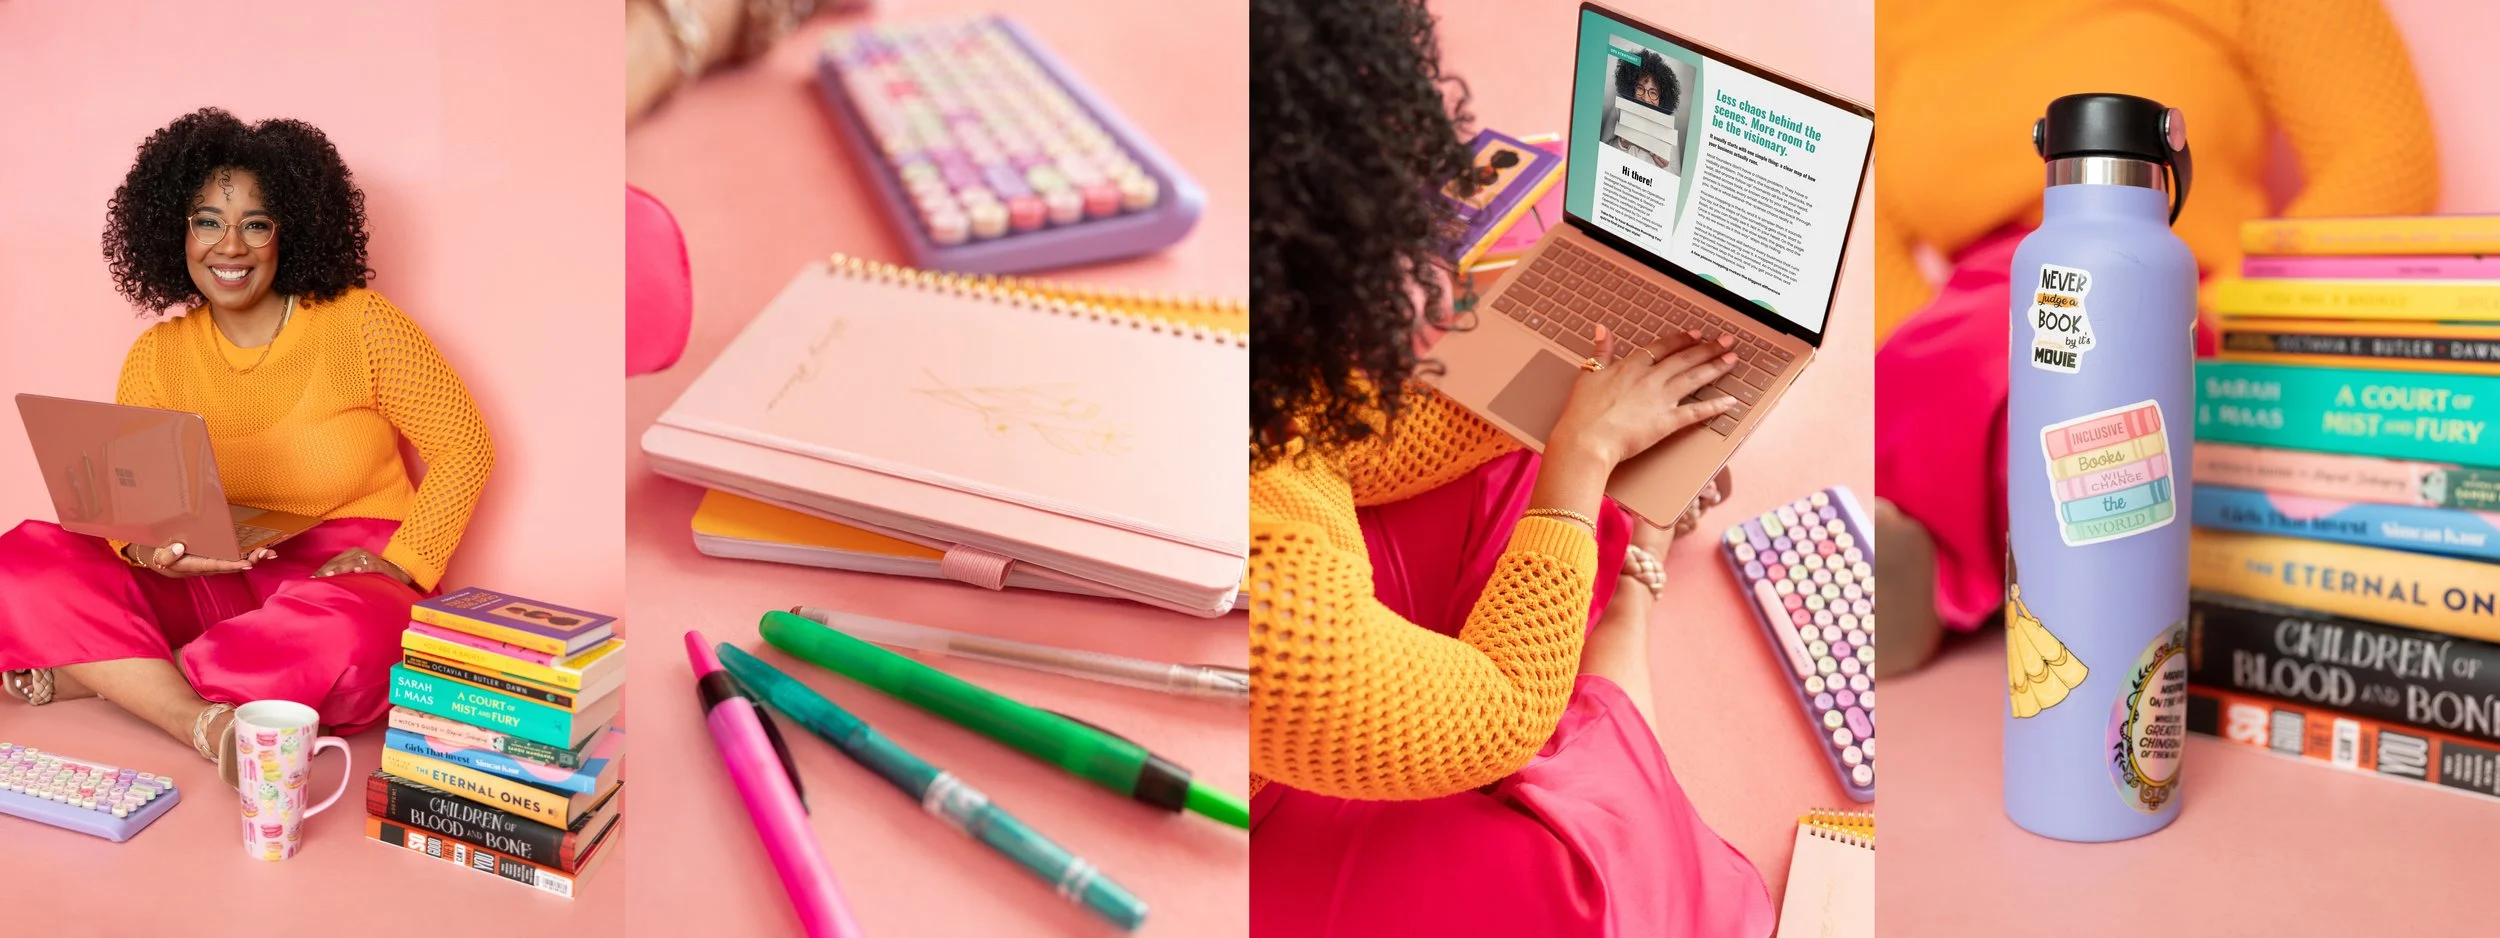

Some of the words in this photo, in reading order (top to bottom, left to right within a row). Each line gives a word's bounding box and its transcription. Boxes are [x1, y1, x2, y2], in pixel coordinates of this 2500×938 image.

[1716, 89, 1737, 107] Less
[1738, 98, 1767, 119] chaos
[1768, 110, 1802, 133] behind
[1804, 125, 1822, 141] the
[1712, 114, 1723, 129] be
[1725, 120, 1741, 136] the
[1742, 128, 1789, 158] visionary.
[1714, 104, 1748, 126] scenes.
[1750, 117, 1775, 136] More
[1776, 130, 1802, 148] room
[1804, 139, 1816, 153] to
[1713, 135, 1726, 145] usually
[1727, 140, 1738, 149] starts
[1754, 152, 1767, 162] simple
[1783, 164, 1793, 172] clear
[1793, 169, 1802, 177] map
[1622, 165, 1630, 176] Hi
[1631, 169, 1652, 187] there!
[2042, 269, 2087, 292] NEVER
[2038, 293, 2068, 308] judge
[2069, 299, 2078, 307] a
[2039, 309, 2082, 334] BOOK
[2066, 337, 2077, 349] by
[2078, 332, 2090, 344] it's
[2450, 341, 2500, 360] DAWN
[2034, 347, 2077, 368] MOVIE
[2334, 384, 2355, 407] A
[2362, 385, 2451, 412] COURT
[2072, 422, 2124, 445] INCLUSIVE
[2322, 410, 2382, 436] MIST
[2415, 417, 2485, 444] FURY
[2078, 450, 2125, 472] Books
[2092, 472, 2143, 491] CHANGE
[2101, 469, 2134, 482] WILL
[2102, 496, 2126, 511] the
[2088, 513, 2145, 536] WORLD
[2283, 561, 2427, 606] ETERNAL
[2274, 618, 2453, 682] CHILDREN
[2452, 658, 2483, 680] OF
[398, 677, 432, 692] SARAH
[432, 664, 462, 676] OCTAVIA
[473, 674, 499, 686] BUTLER
[506, 683, 528, 694] DAWN
[2232, 650, 2356, 706] BLOOD
[2361, 684, 2400, 706] AND
[395, 688, 400, 697] J.
[404, 690, 434, 705] MAAS
[458, 692, 465, 700] A
[468, 694, 506, 711] COURT
[452, 702, 477, 716] MIST
[492, 712, 520, 727] FURY
[2226, 704, 2270, 746] SO
[405, 743, 423, 753] Girls
[426, 747, 443, 759] That
[445, 752, 470, 764] Invest
[416, 766, 428, 775] THE
[432, 770, 494, 798] ETERNAL
[500, 792, 540, 813] ONES
[430, 797, 504, 832] CHILDREN
[504, 821, 516, 832] OF
[411, 808, 464, 837] BLOOD
[467, 829, 482, 840] AND
[486, 831, 532, 858] BONE
[408, 832, 425, 851] SO
[443, 843, 453, 859] THEY
[474, 851, 494, 870] YOU
